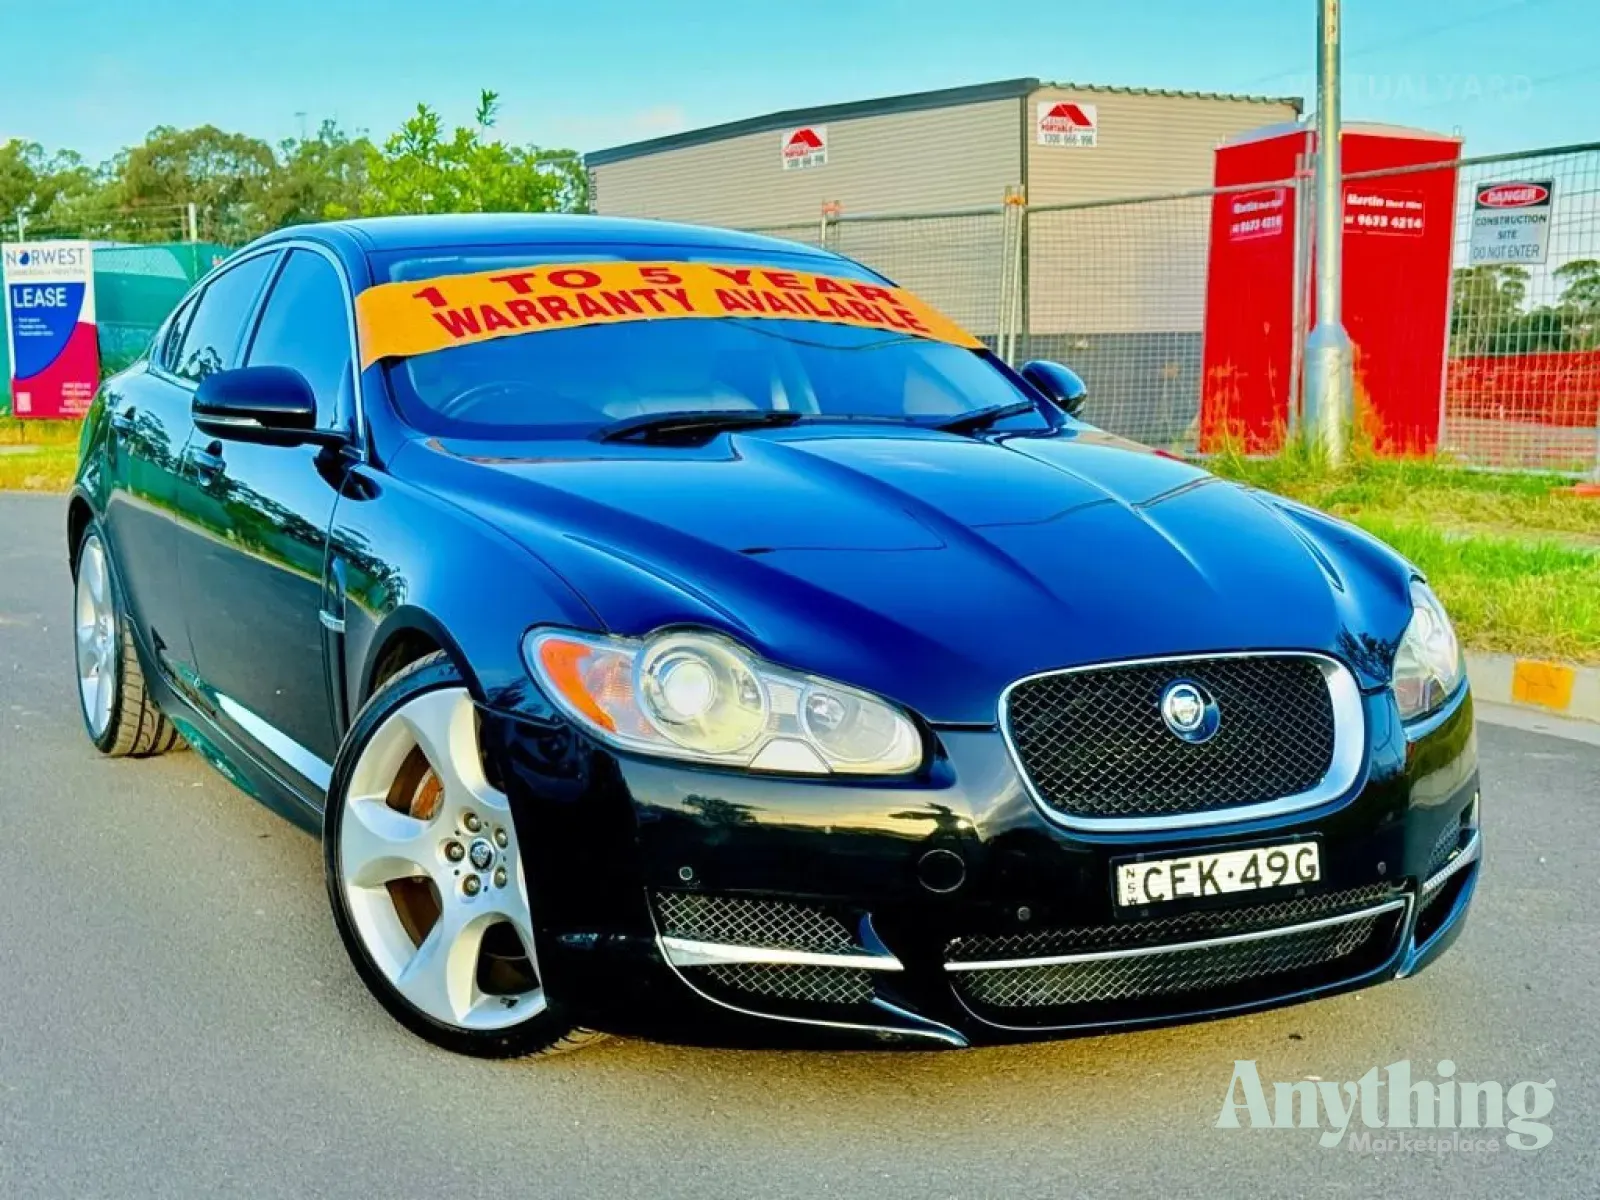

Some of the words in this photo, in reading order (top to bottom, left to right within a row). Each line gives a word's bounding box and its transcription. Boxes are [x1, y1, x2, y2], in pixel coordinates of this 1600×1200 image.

[1487, 188, 1537, 203] DANGER
[1474, 214, 1547, 227] CONSTRUCTION
[1497, 230, 1518, 240] SITE
[5, 248, 85, 267] NORWEST
[1473, 246, 1486, 260] DO
[1487, 245, 1507, 258] NOT
[1507, 243, 1540, 258] ENTER
[412, 286, 449, 309] 1
[490, 268, 603, 296] TO
[638, 266, 683, 286] 5
[707, 266, 902, 307] YEAR
[13, 287, 67, 308] LEASE
[431, 287, 696, 339] WARRANTY
[713, 288, 932, 334] AVAILABLE
